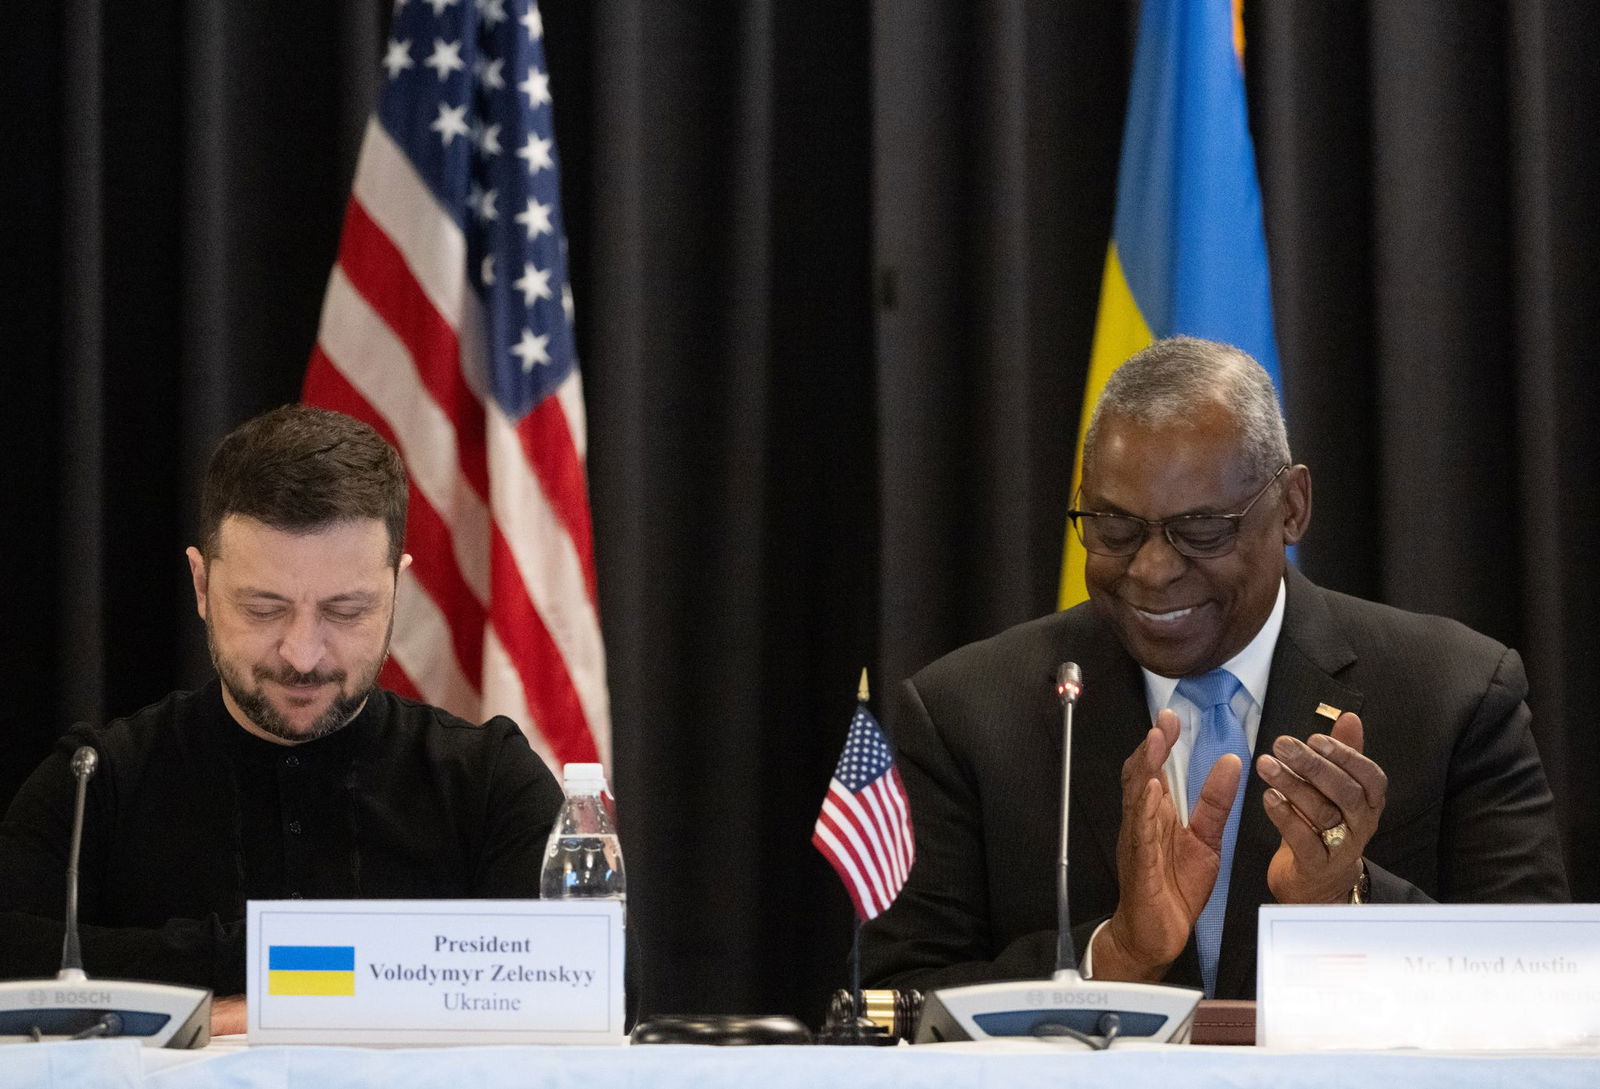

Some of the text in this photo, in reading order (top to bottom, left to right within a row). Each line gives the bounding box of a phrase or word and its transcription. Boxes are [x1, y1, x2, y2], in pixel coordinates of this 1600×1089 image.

[434, 935, 531, 953] President
[369, 963, 596, 988] Volodymyr Zelenskyy
[1447, 956, 1505, 978] Lloyd
[1511, 956, 1578, 975] Austin
[55, 991, 111, 1004] BOSCH
[443, 992, 522, 1012] Ukraine
[1052, 992, 1109, 1005] BOSCH
